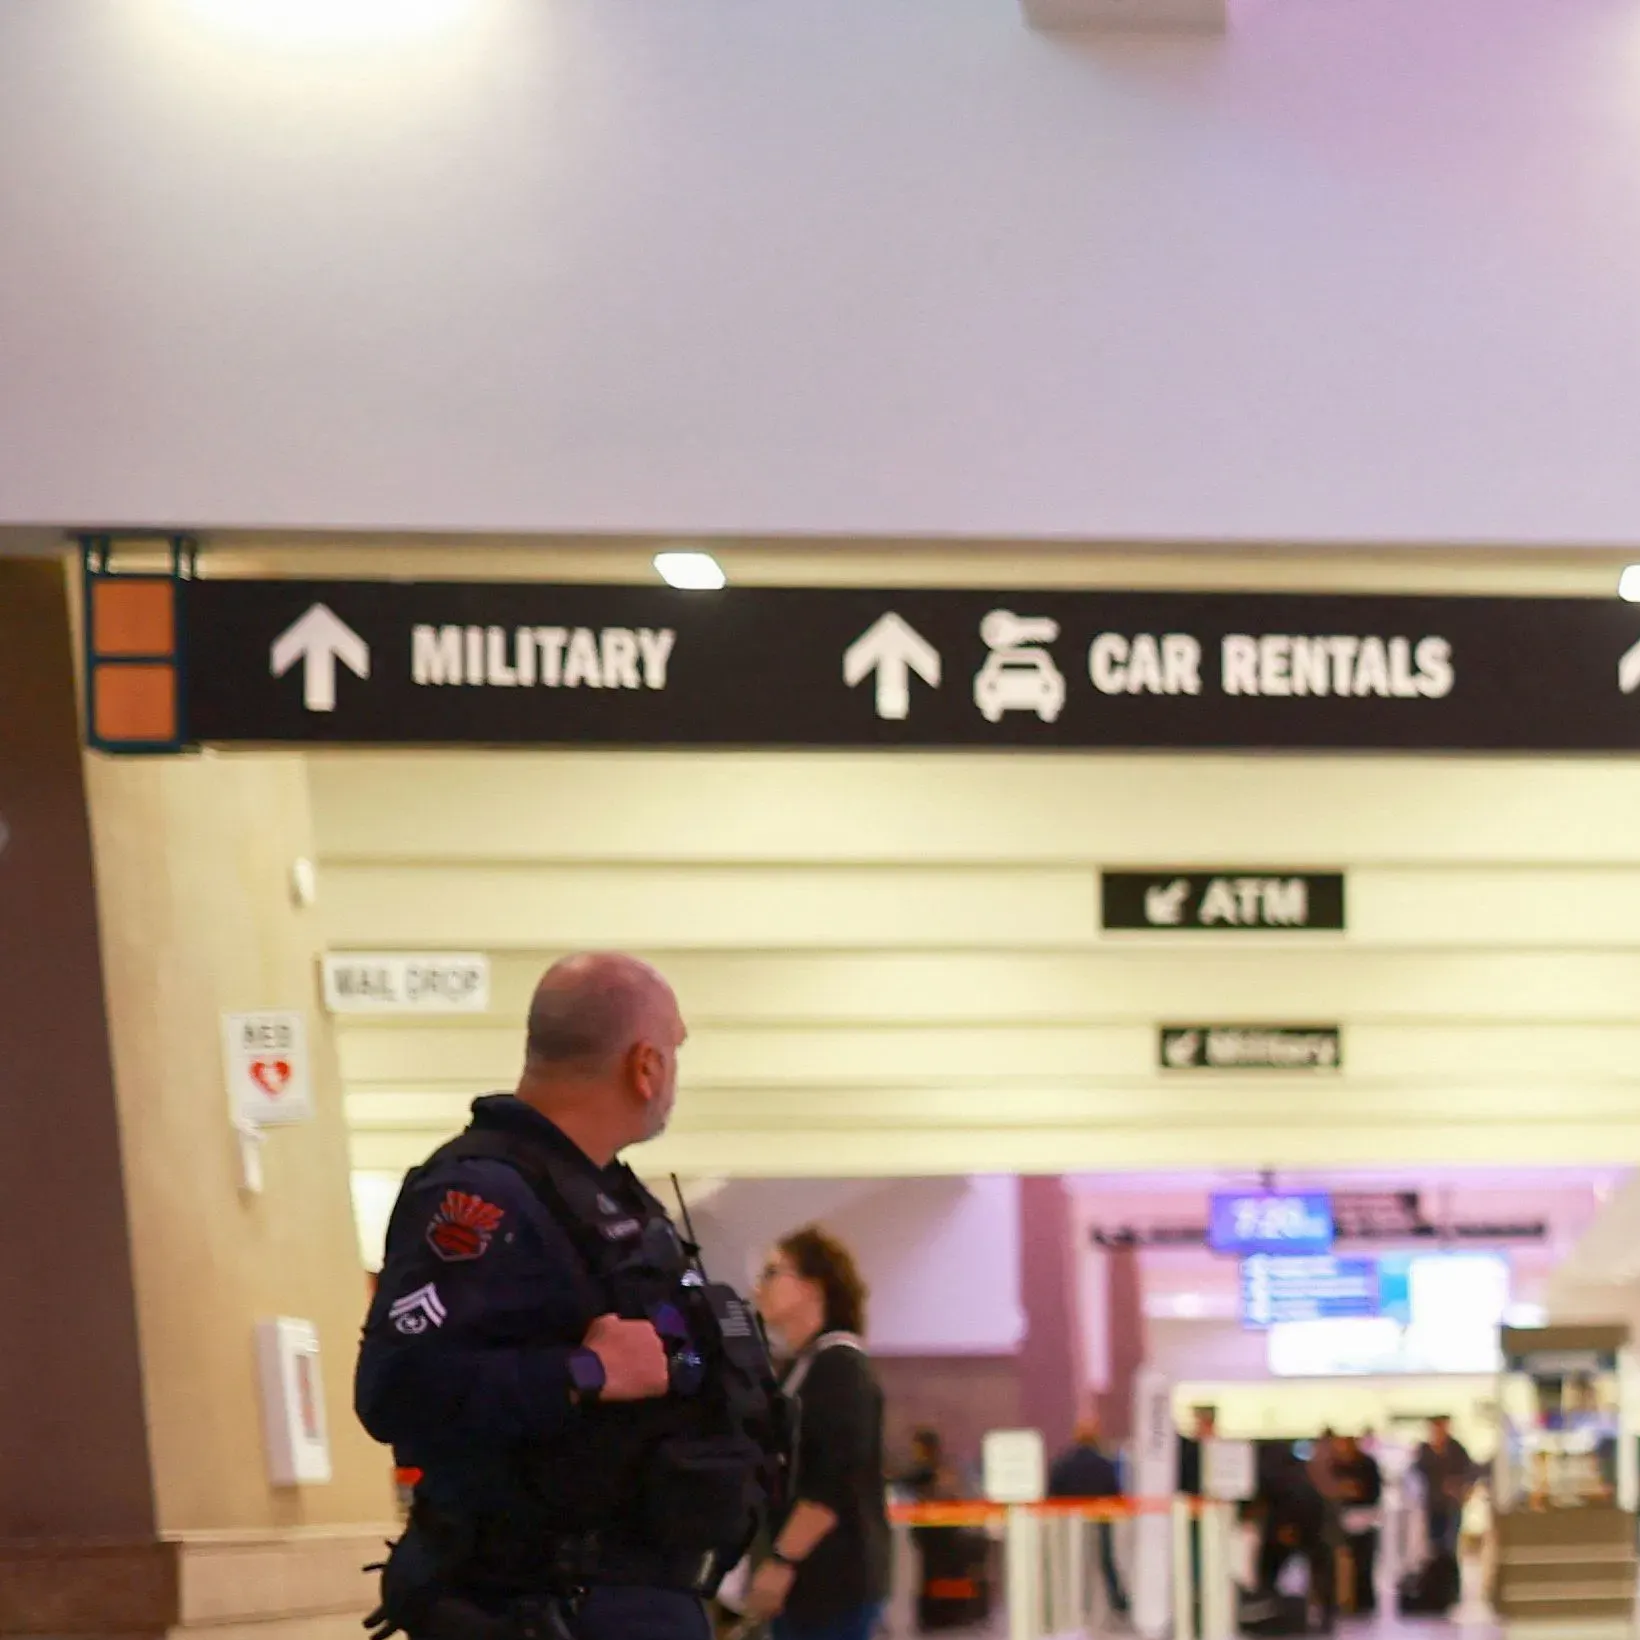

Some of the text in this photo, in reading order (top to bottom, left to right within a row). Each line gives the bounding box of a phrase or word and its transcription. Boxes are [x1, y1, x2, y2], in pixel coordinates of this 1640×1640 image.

[411, 625, 676, 690] MILITARY
[1089, 633, 1455, 698] CAR RENTALS
[1199, 878, 1308, 924] ATM
[333, 966, 481, 1002] MAIL DROP
[243, 1020, 292, 1050] AED
